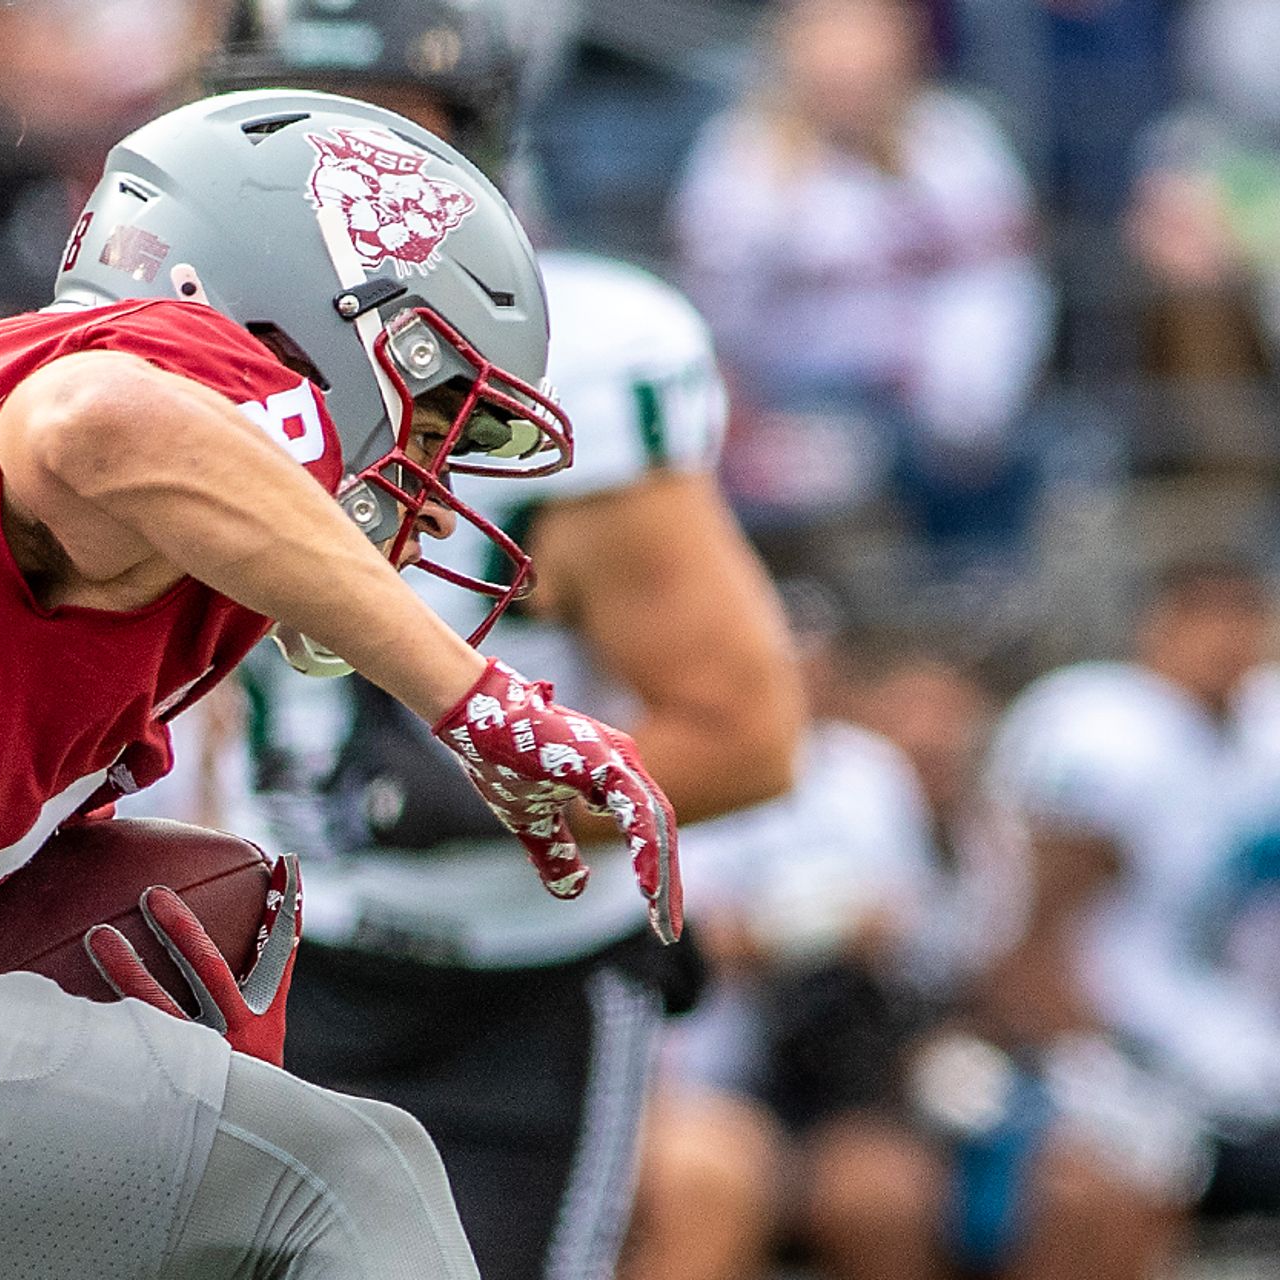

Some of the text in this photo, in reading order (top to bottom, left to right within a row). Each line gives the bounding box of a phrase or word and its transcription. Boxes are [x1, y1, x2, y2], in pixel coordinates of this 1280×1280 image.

[345, 136, 418, 172] WSC
[62, 211, 95, 272] 8
[450, 724, 484, 762] WSU
[510, 718, 537, 753] WSU
